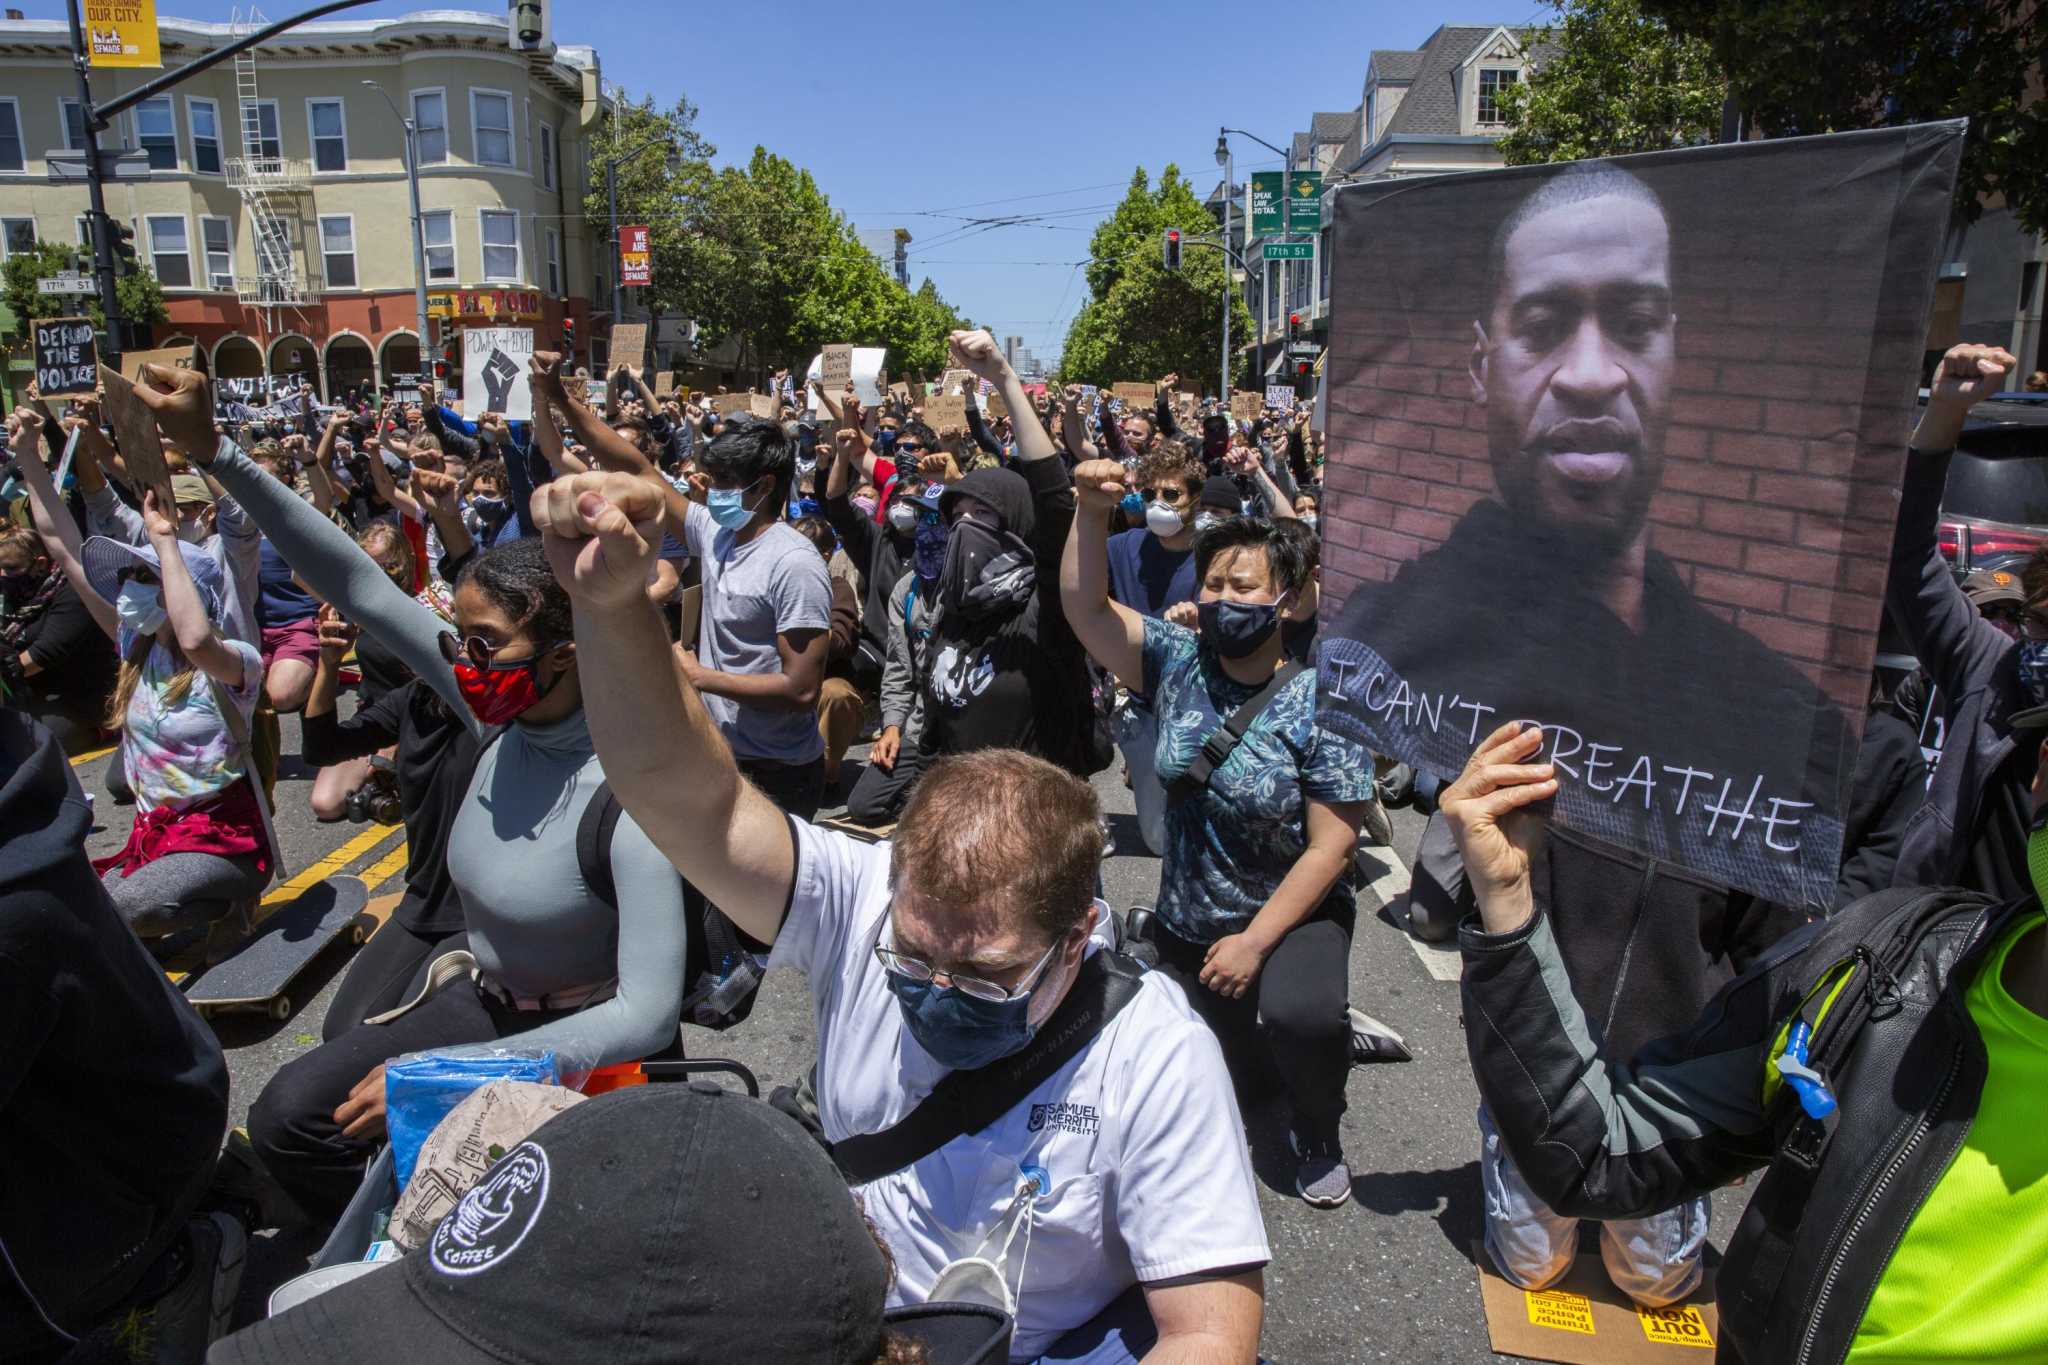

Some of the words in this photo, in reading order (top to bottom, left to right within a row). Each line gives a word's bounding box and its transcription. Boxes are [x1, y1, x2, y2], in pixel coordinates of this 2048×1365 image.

[88, 8, 111, 21] OUR
[115, 9, 143, 22] CITY.
[1253, 192, 1272, 200] SPEAK
[1253, 200, 1267, 208] LAW
[1253, 207, 1263, 215] TO
[634, 231, 647, 241] WE
[632, 241, 647, 251] ARE
[1268, 247, 1289, 256] 17th
[1294, 247, 1305, 256] St
[625, 271, 649, 280] SFMADE
[46, 281, 65, 290] 17TH
[77, 280, 90, 290] ST
[456, 290, 483, 314] EL
[489, 290, 538, 314] TORO
[38, 325, 94, 347] DEFUND
[44, 347, 81, 365] THE
[39, 364, 96, 391] POLICE
[1328, 658, 1356, 702] I
[1365, 672, 1496, 745] CAN'T
[1047, 1103, 1100, 1118] SAMUEL
[1047, 1115, 1100, 1129] MERRITT
[1046, 1124, 1099, 1136] UNIVERSITY
[444, 1245, 496, 1264] COFFEE
[1538, 1307, 1586, 1322] Pence
[1641, 1306, 1698, 1325] NOW
[1535, 1314, 1593, 1332] Trump/
[1651, 1322, 1701, 1336] OUT
[1648, 1333, 1714, 1346] Trump/Pence
